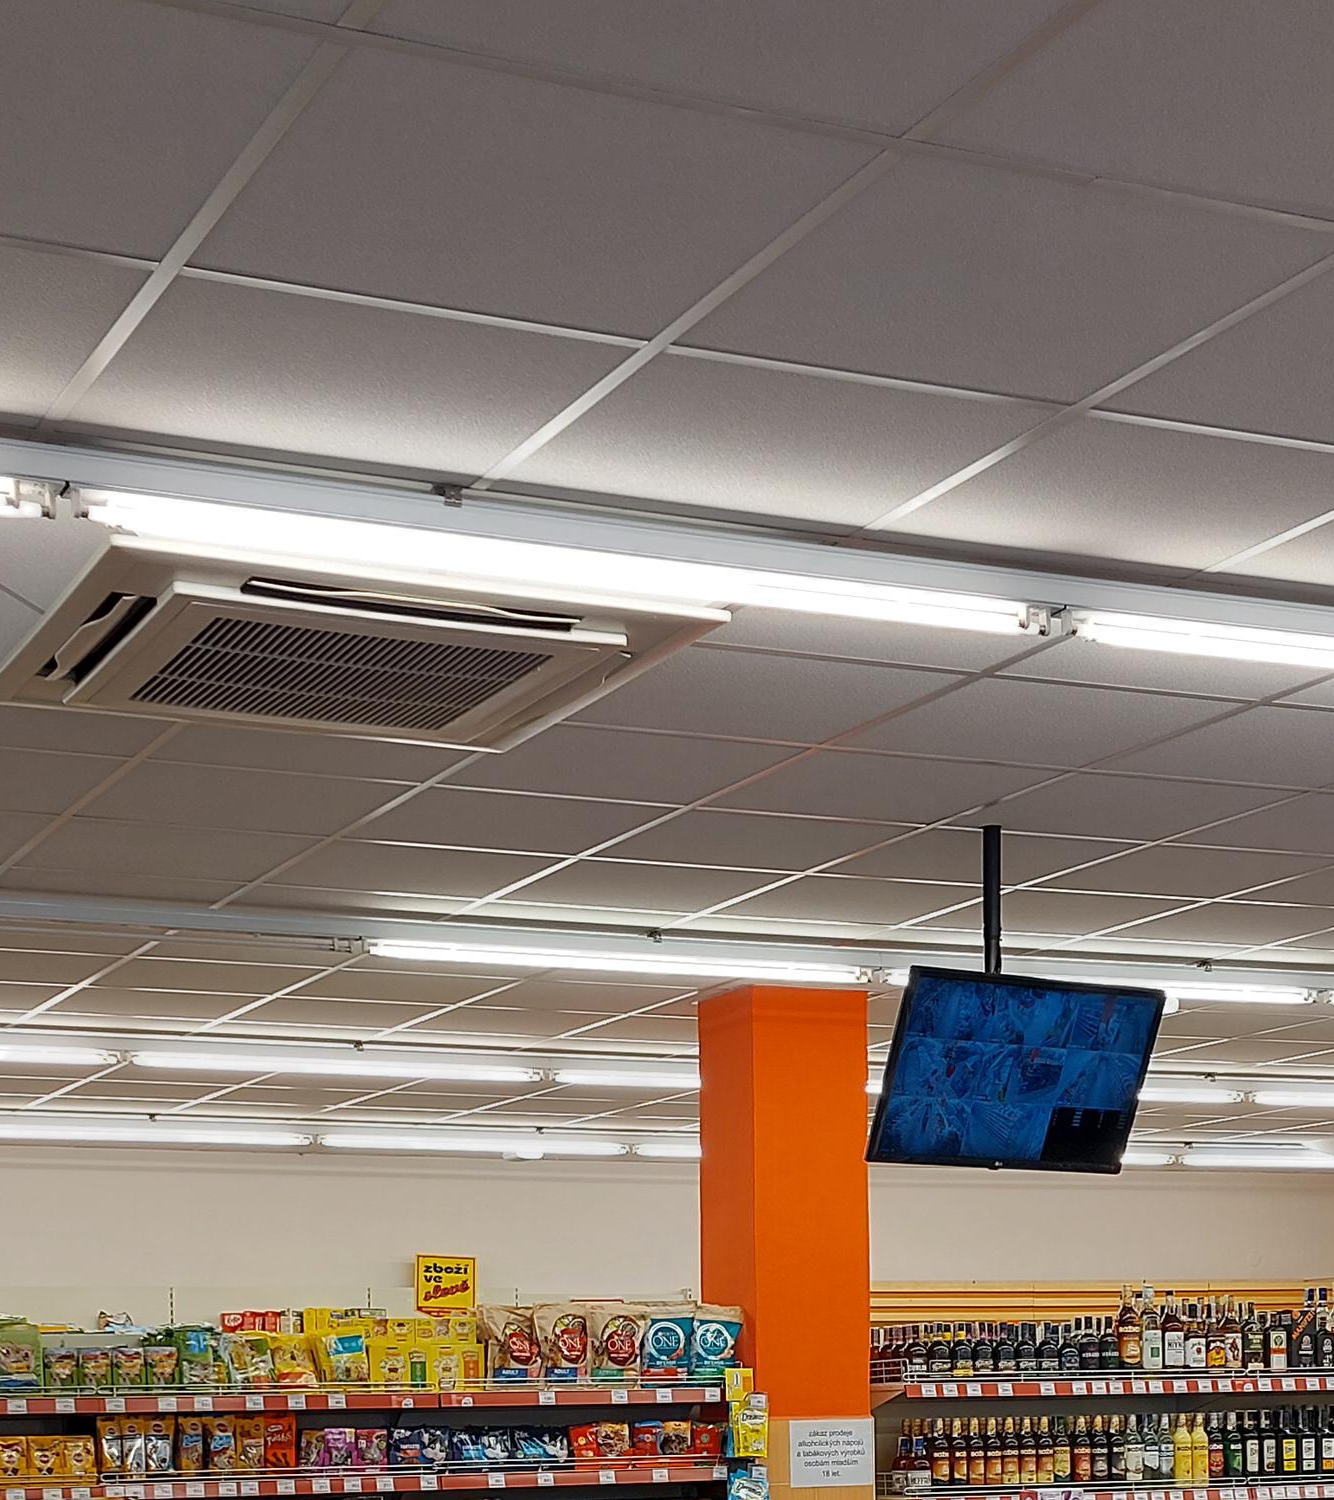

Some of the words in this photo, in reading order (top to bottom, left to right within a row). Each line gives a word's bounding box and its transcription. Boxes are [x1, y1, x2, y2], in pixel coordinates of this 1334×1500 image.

[423, 1263, 469, 1275] zboží
[423, 1275, 443, 1284] ve
[607, 1338, 632, 1351] ONE
[652, 1336, 679, 1348] ONE
